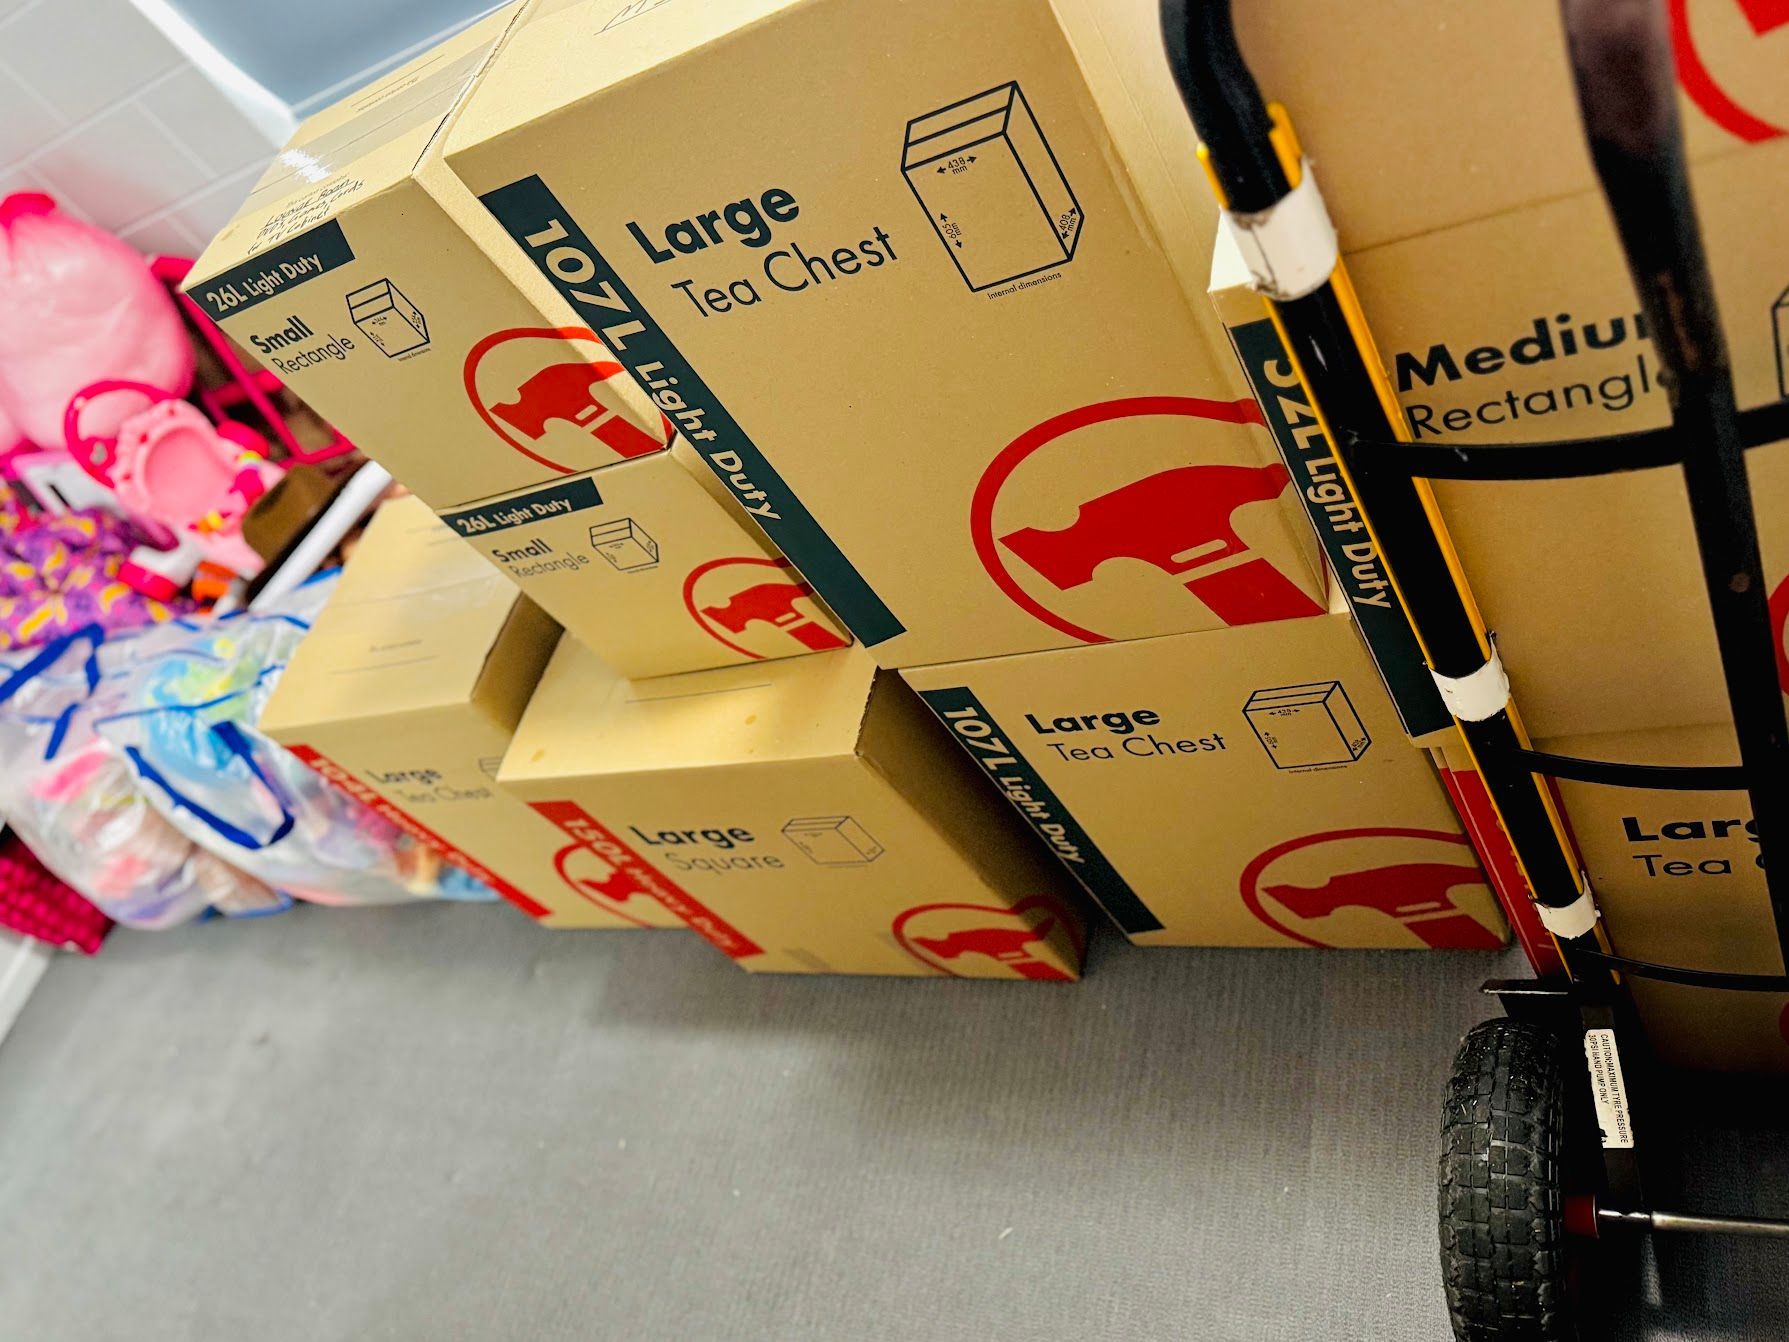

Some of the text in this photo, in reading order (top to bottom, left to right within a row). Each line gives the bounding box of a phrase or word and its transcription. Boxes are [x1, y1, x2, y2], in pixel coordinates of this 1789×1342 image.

[947, 157, 967, 170] 438
[952, 165, 968, 175] mm
[625, 188, 801, 265] Large
[206, 254, 323, 313] 26L Light Duty
[671, 225, 899, 318] Tea Chest
[987, 272, 1063, 301] Internal dimensions
[250, 315, 315, 355] Small
[271, 333, 356, 375] Rectangle
[1405, 354, 1666, 439] Rectangl
[634, 361, 719, 442] Light
[708, 450, 782, 521] Duty
[456, 497, 572, 534] 26L Light Duty
[1304, 456, 1355, 536] Light
[1341, 540, 1392, 610] Duty
[492, 537, 553, 564] Small
[510, 551, 590, 578] Rectangle
[1024, 708, 1161, 735] Large
[1047, 732, 1228, 763] Tea Chest
[366, 768, 442, 786] Large
[1000, 775, 1047, 824] Light
[1039, 823, 1085, 864] Duty
[1622, 817, 1761, 843] Lar
[562, 818, 634, 868] 150L
[628, 825, 755, 850] Large
[665, 852, 785, 876] Square
[1633, 854, 1732, 877] Tea
[1592, 1052, 1603, 1070] HAND
[1596, 1070, 1606, 1088] PUMP
[1599, 1087, 1610, 1105] ONLY
[1613, 1092, 1623, 1109] TYRE
[1615, 1109, 1629, 1143] PRESSURE
